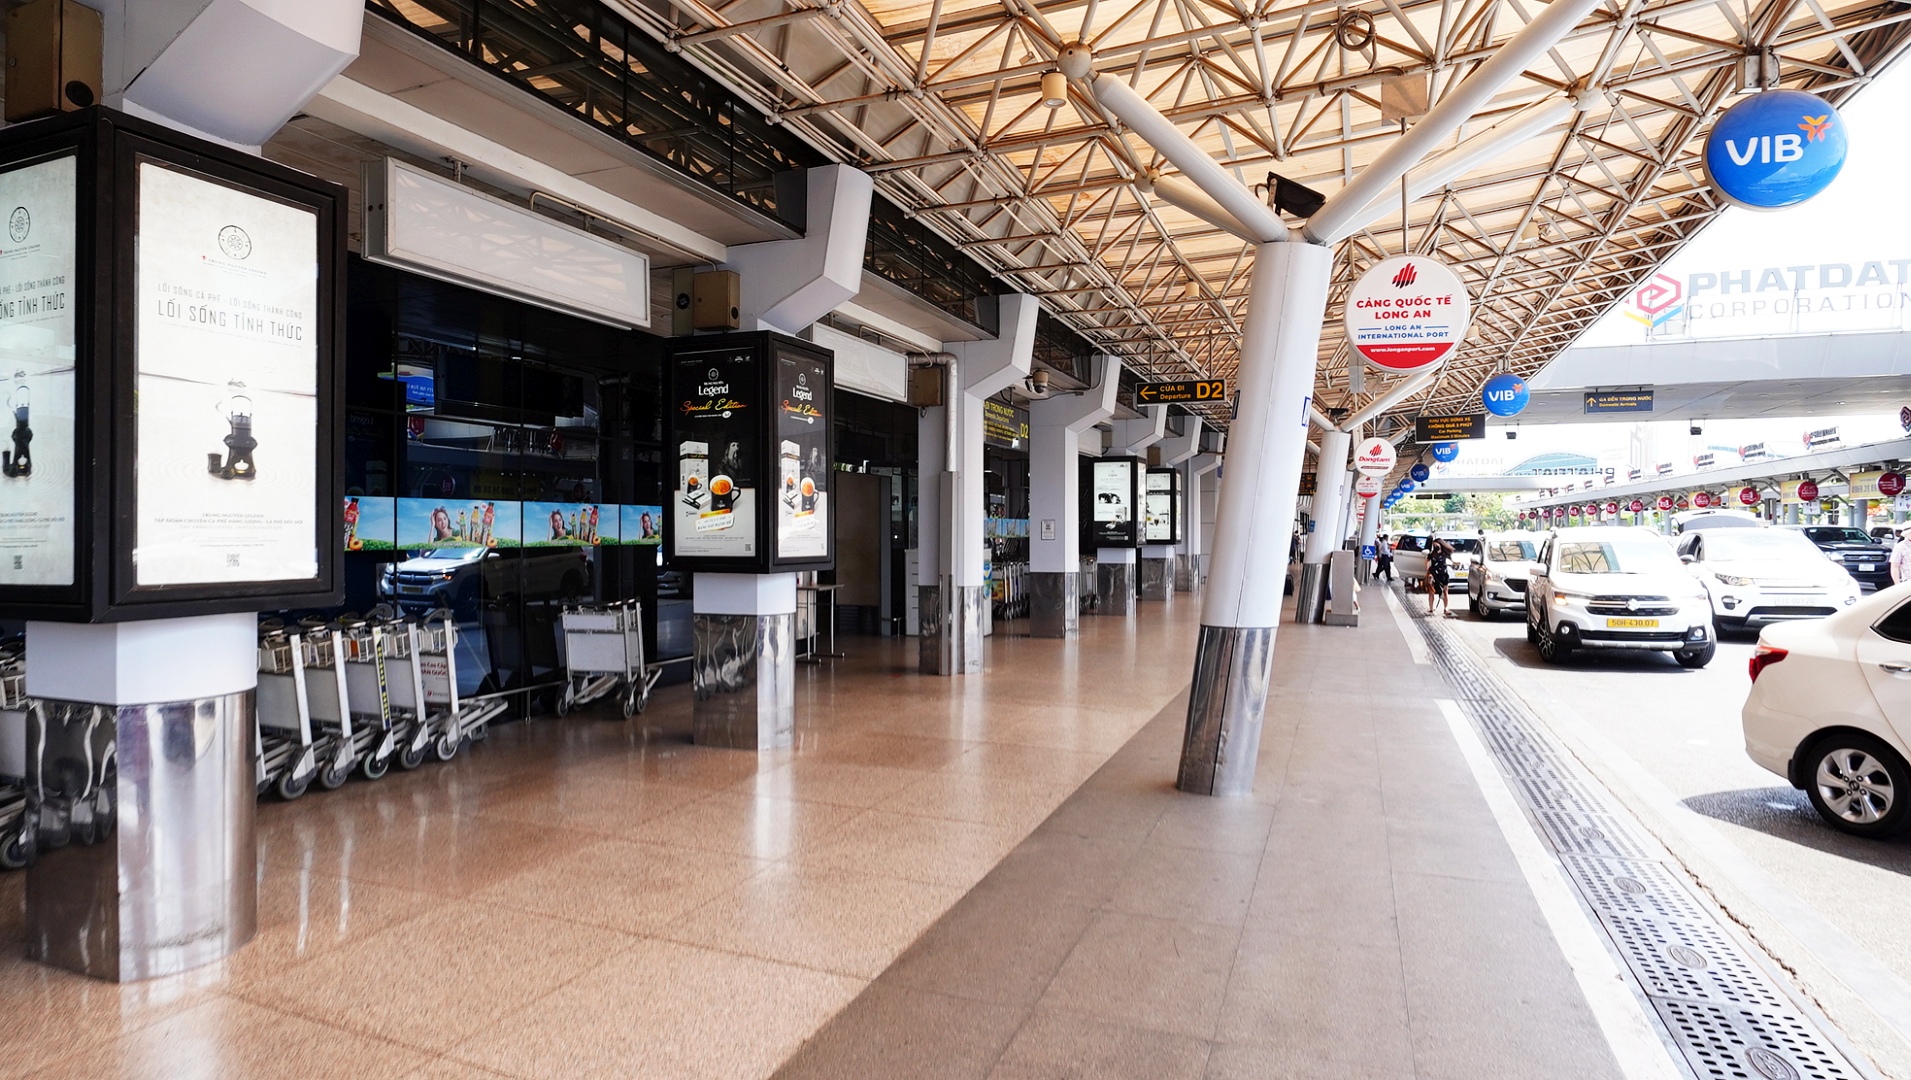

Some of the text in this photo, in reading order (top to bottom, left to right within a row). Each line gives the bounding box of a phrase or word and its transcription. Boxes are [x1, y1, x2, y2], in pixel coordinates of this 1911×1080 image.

[1725, 134, 1804, 166] VIB
[1689, 258, 1911, 297] PHATDAT
[1356, 293, 1453, 309] CẢNG QUỐC TẾ
[1375, 310, 1431, 320] LONG AN
[1358, 332, 1424, 340] INTERNATIONAL
[698, 384, 729, 397] Legend
[1197, 382, 1223, 398] D2
[1488, 389, 1515, 402] VIB
[680, 400, 713, 415] Special
[715, 398, 748, 410] Edition
[1435, 447, 1452, 455] VIB
